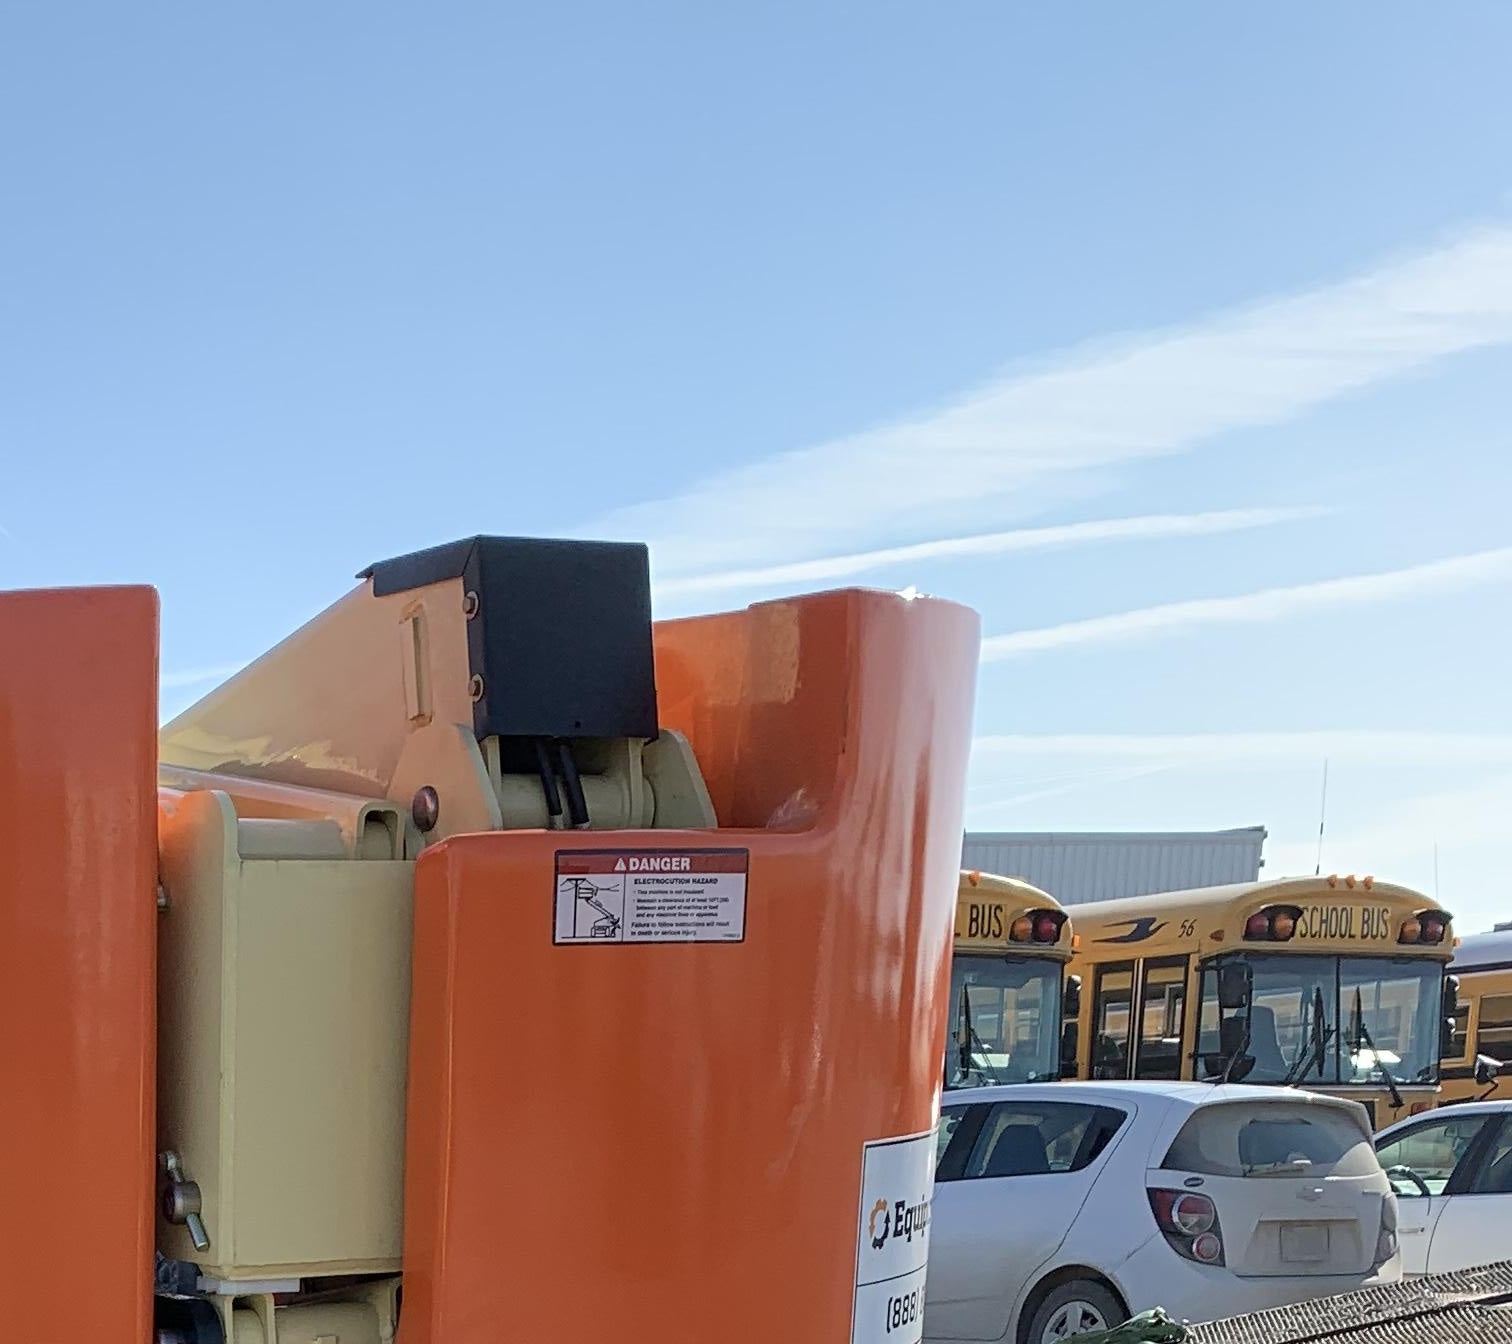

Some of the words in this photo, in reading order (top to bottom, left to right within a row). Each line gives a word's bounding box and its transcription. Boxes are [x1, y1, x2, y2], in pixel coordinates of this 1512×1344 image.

[629, 857, 691, 871] DANGER
[968, 904, 1003, 938] BUS
[1178, 919, 1197, 938] 56
[1300, 906, 1356, 938] SCHOOL
[1360, 907, 1389, 939] BUS
